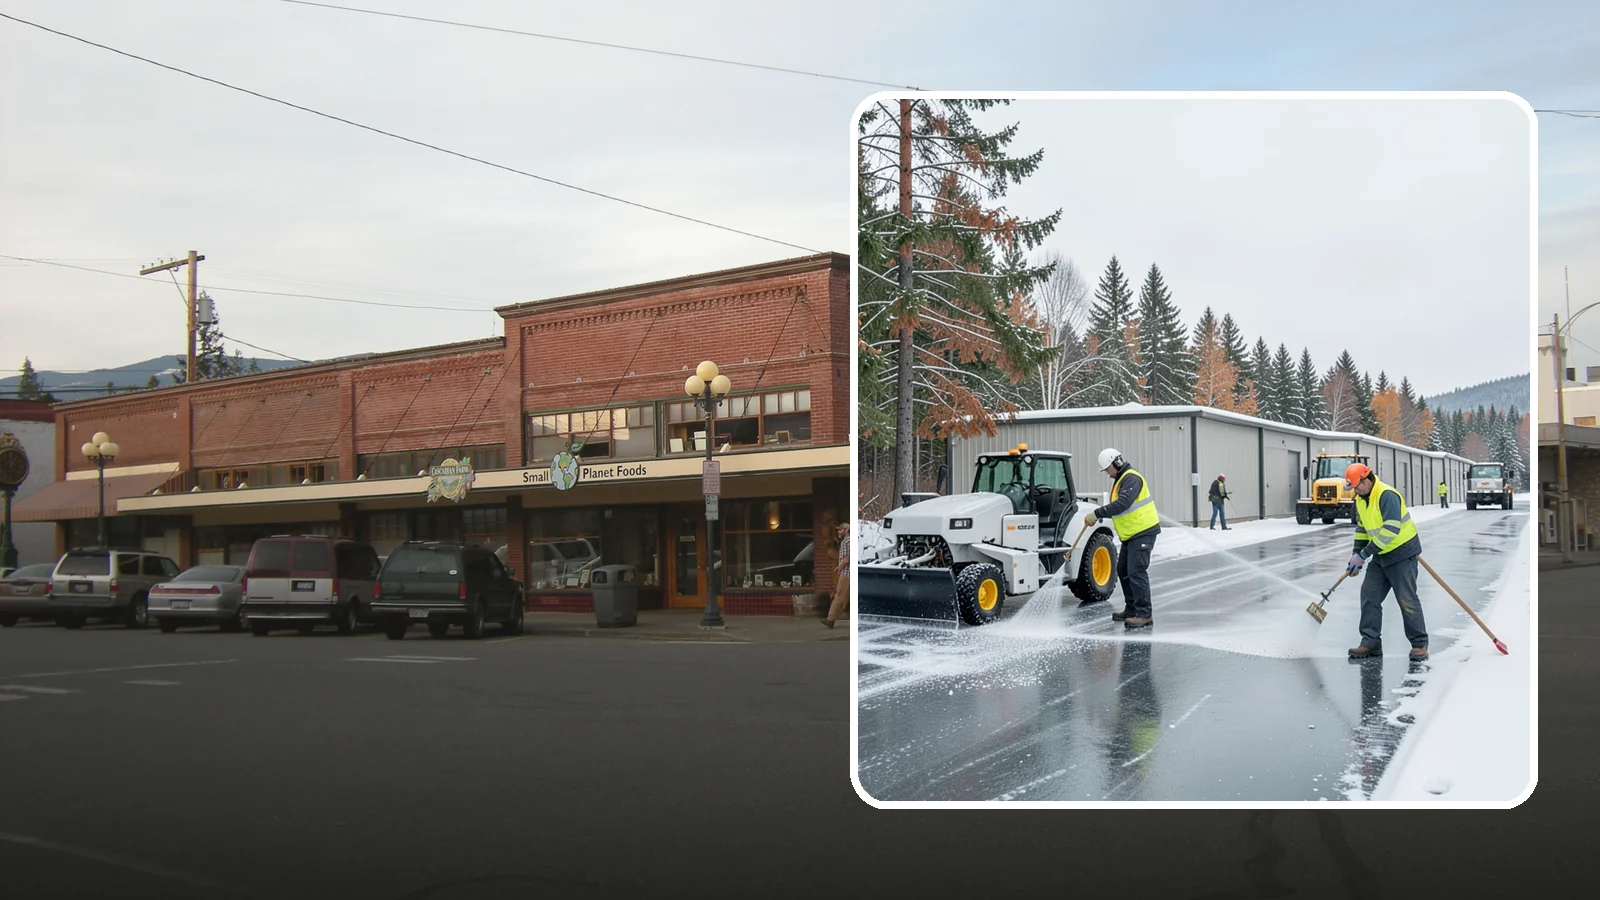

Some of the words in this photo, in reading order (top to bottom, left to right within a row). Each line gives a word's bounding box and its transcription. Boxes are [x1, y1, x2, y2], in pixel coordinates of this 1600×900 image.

[523, 471, 549, 483] Small
[583, 467, 614, 479] Planet
[617, 464, 647, 477] Foods
